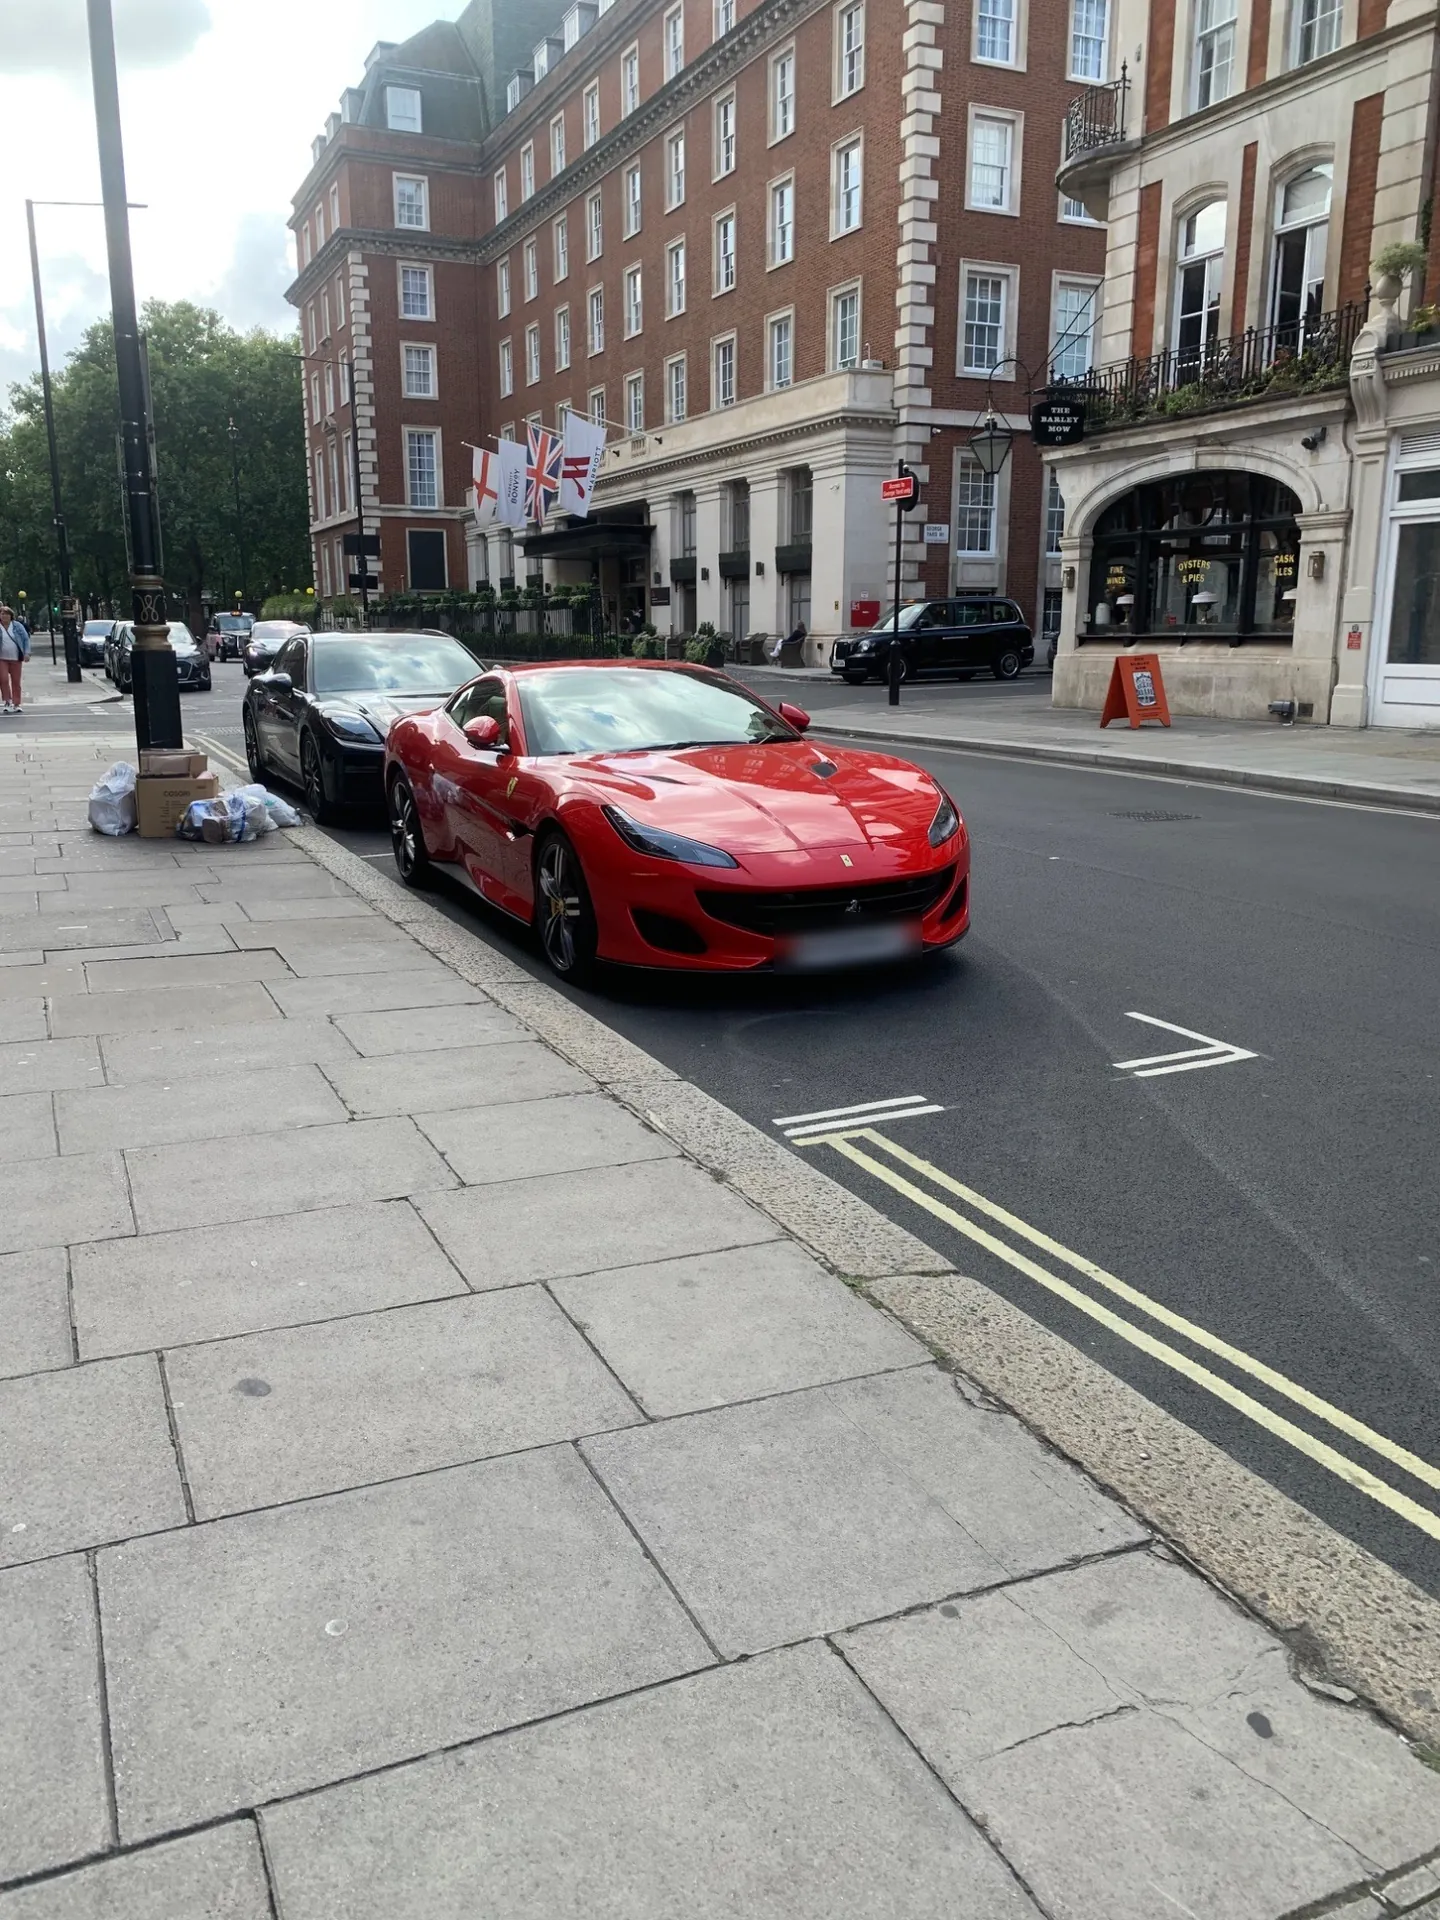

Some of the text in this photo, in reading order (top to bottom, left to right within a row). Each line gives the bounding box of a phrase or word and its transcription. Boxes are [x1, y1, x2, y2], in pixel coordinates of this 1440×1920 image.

[588, 446, 601, 491] MARRIOTT
[1273, 554, 1295, 564] CASK
[1109, 565, 1124, 574] FINE
[1178, 559, 1212, 572] OYSTERS
[1274, 566, 1293, 576] ALES
[1106, 576, 1126, 585] WINES
[1188, 573, 1205, 583] PIES
